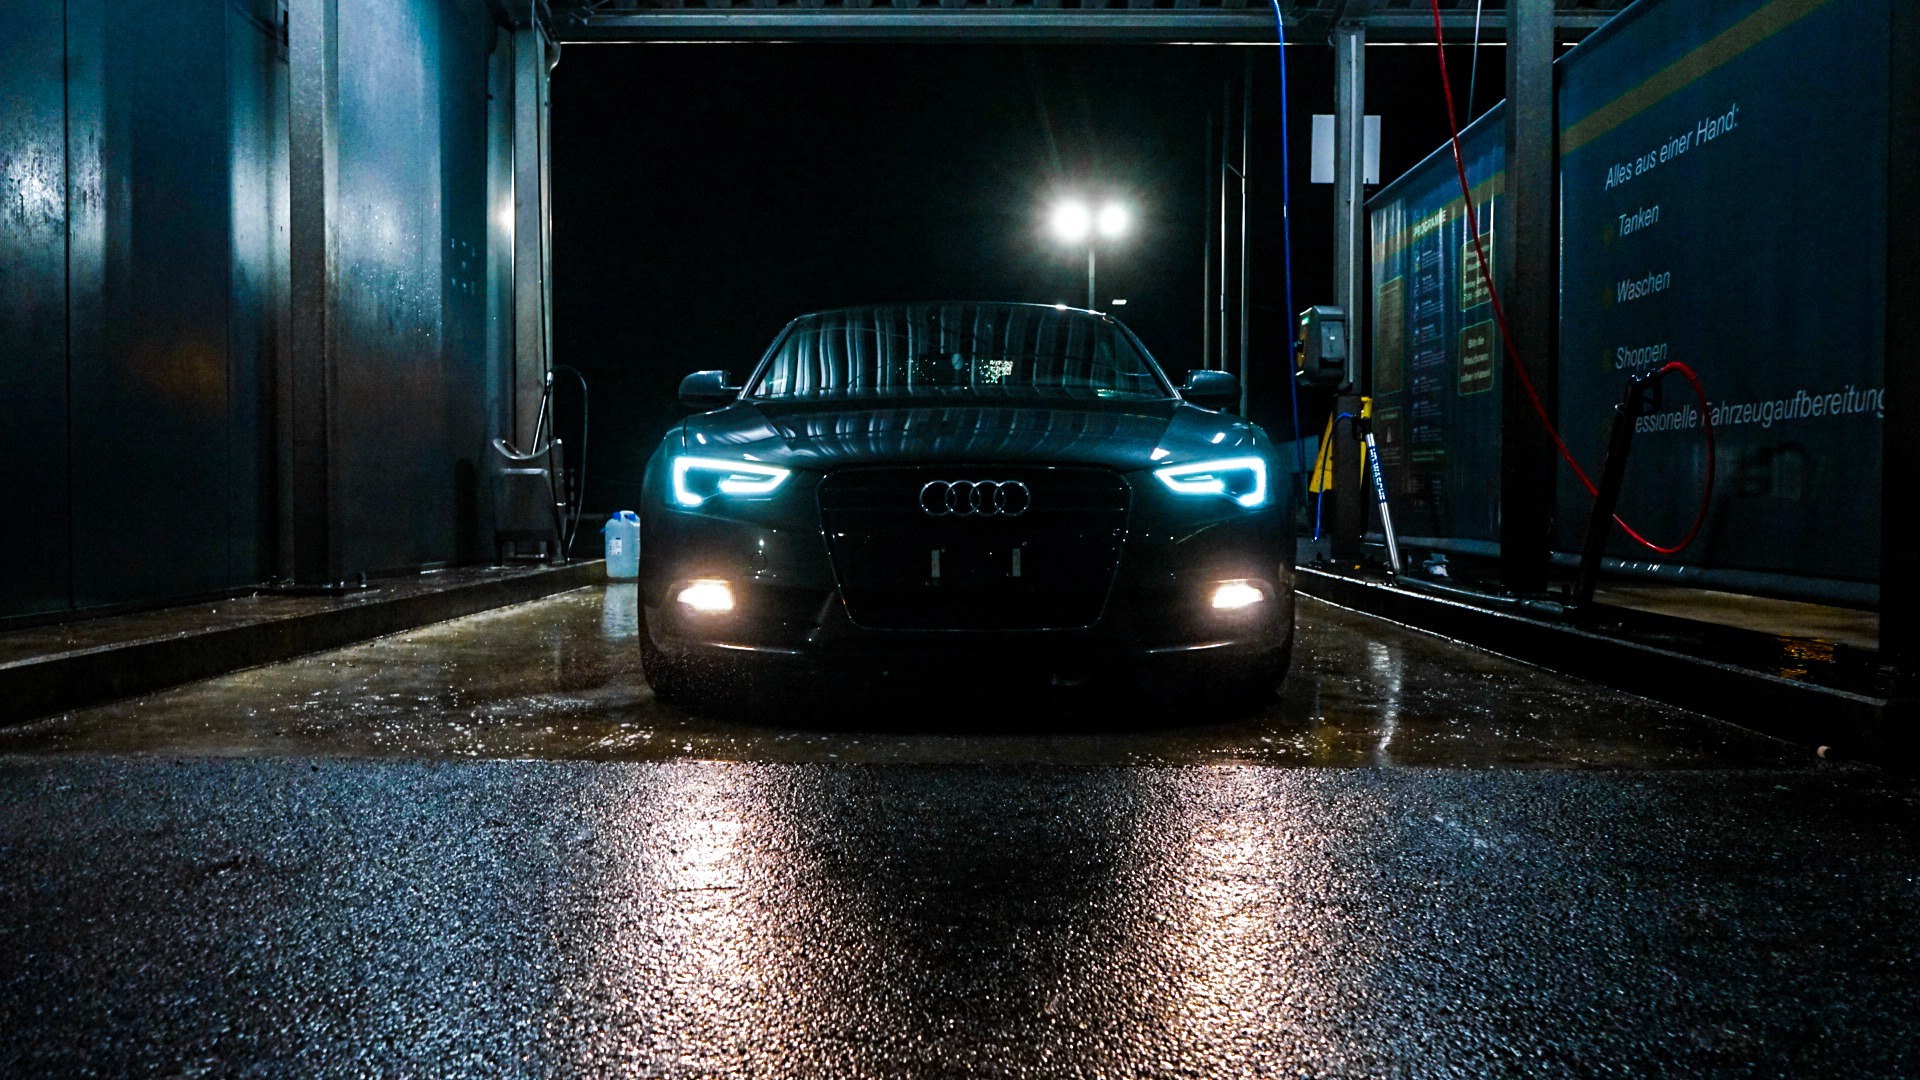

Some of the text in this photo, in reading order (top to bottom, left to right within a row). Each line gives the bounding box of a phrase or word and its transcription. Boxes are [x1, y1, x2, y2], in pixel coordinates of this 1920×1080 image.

[1604, 102, 1740, 191] Alles aus einer Hand:
[1413, 209, 1447, 238] PROGRAME
[1618, 204, 1660, 238] Tanken
[1616, 271, 1671, 304] Waschen
[1615, 342, 1668, 371] Shoppen
[1635, 404, 1698, 434] essionelle
